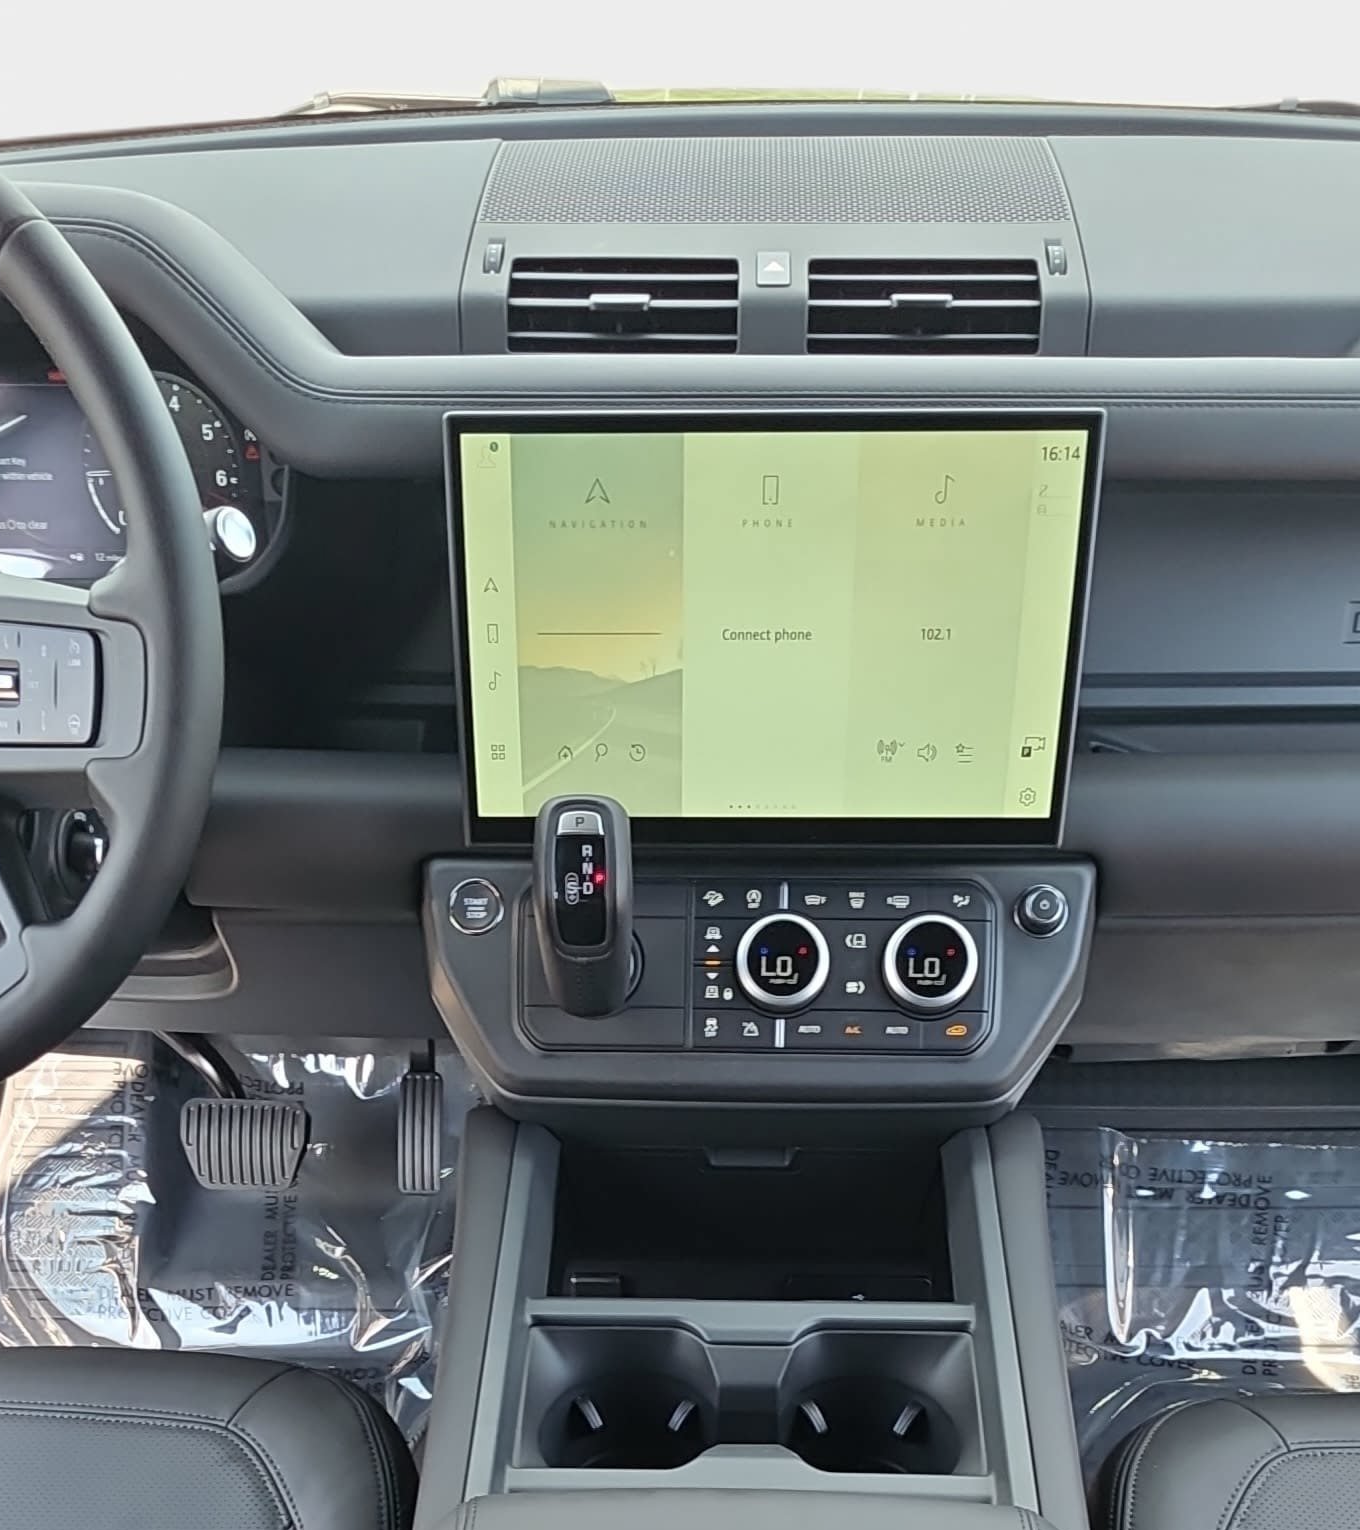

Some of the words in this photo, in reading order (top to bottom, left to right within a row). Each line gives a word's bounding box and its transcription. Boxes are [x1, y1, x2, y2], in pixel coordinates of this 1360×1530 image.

[168, 395, 181, 412] 4
[201, 423, 214, 441] 5
[1041, 446, 1081, 461] 16:14
[215, 469, 228, 487] 6
[548, 519, 648, 529] NAVIGATION
[741, 518, 794, 528] PHONE
[915, 517, 967, 528] MEDIA
[722, 628, 771, 641] Connect
[774, 628, 813, 643] phone
[920, 628, 952, 641] 102.1
[575, 816, 585, 828] P
[582, 844, 593, 857] R
[582, 862, 593, 875] N
[583, 881, 594, 895] D
[761, 956, 793, 977] LO
[908, 956, 940, 978] LO
[1252, 1173, 1273, 1246] REMOVE
[280, 1195, 298, 1280] PROTECTIVE
[261, 1230, 279, 1281] DEALER
